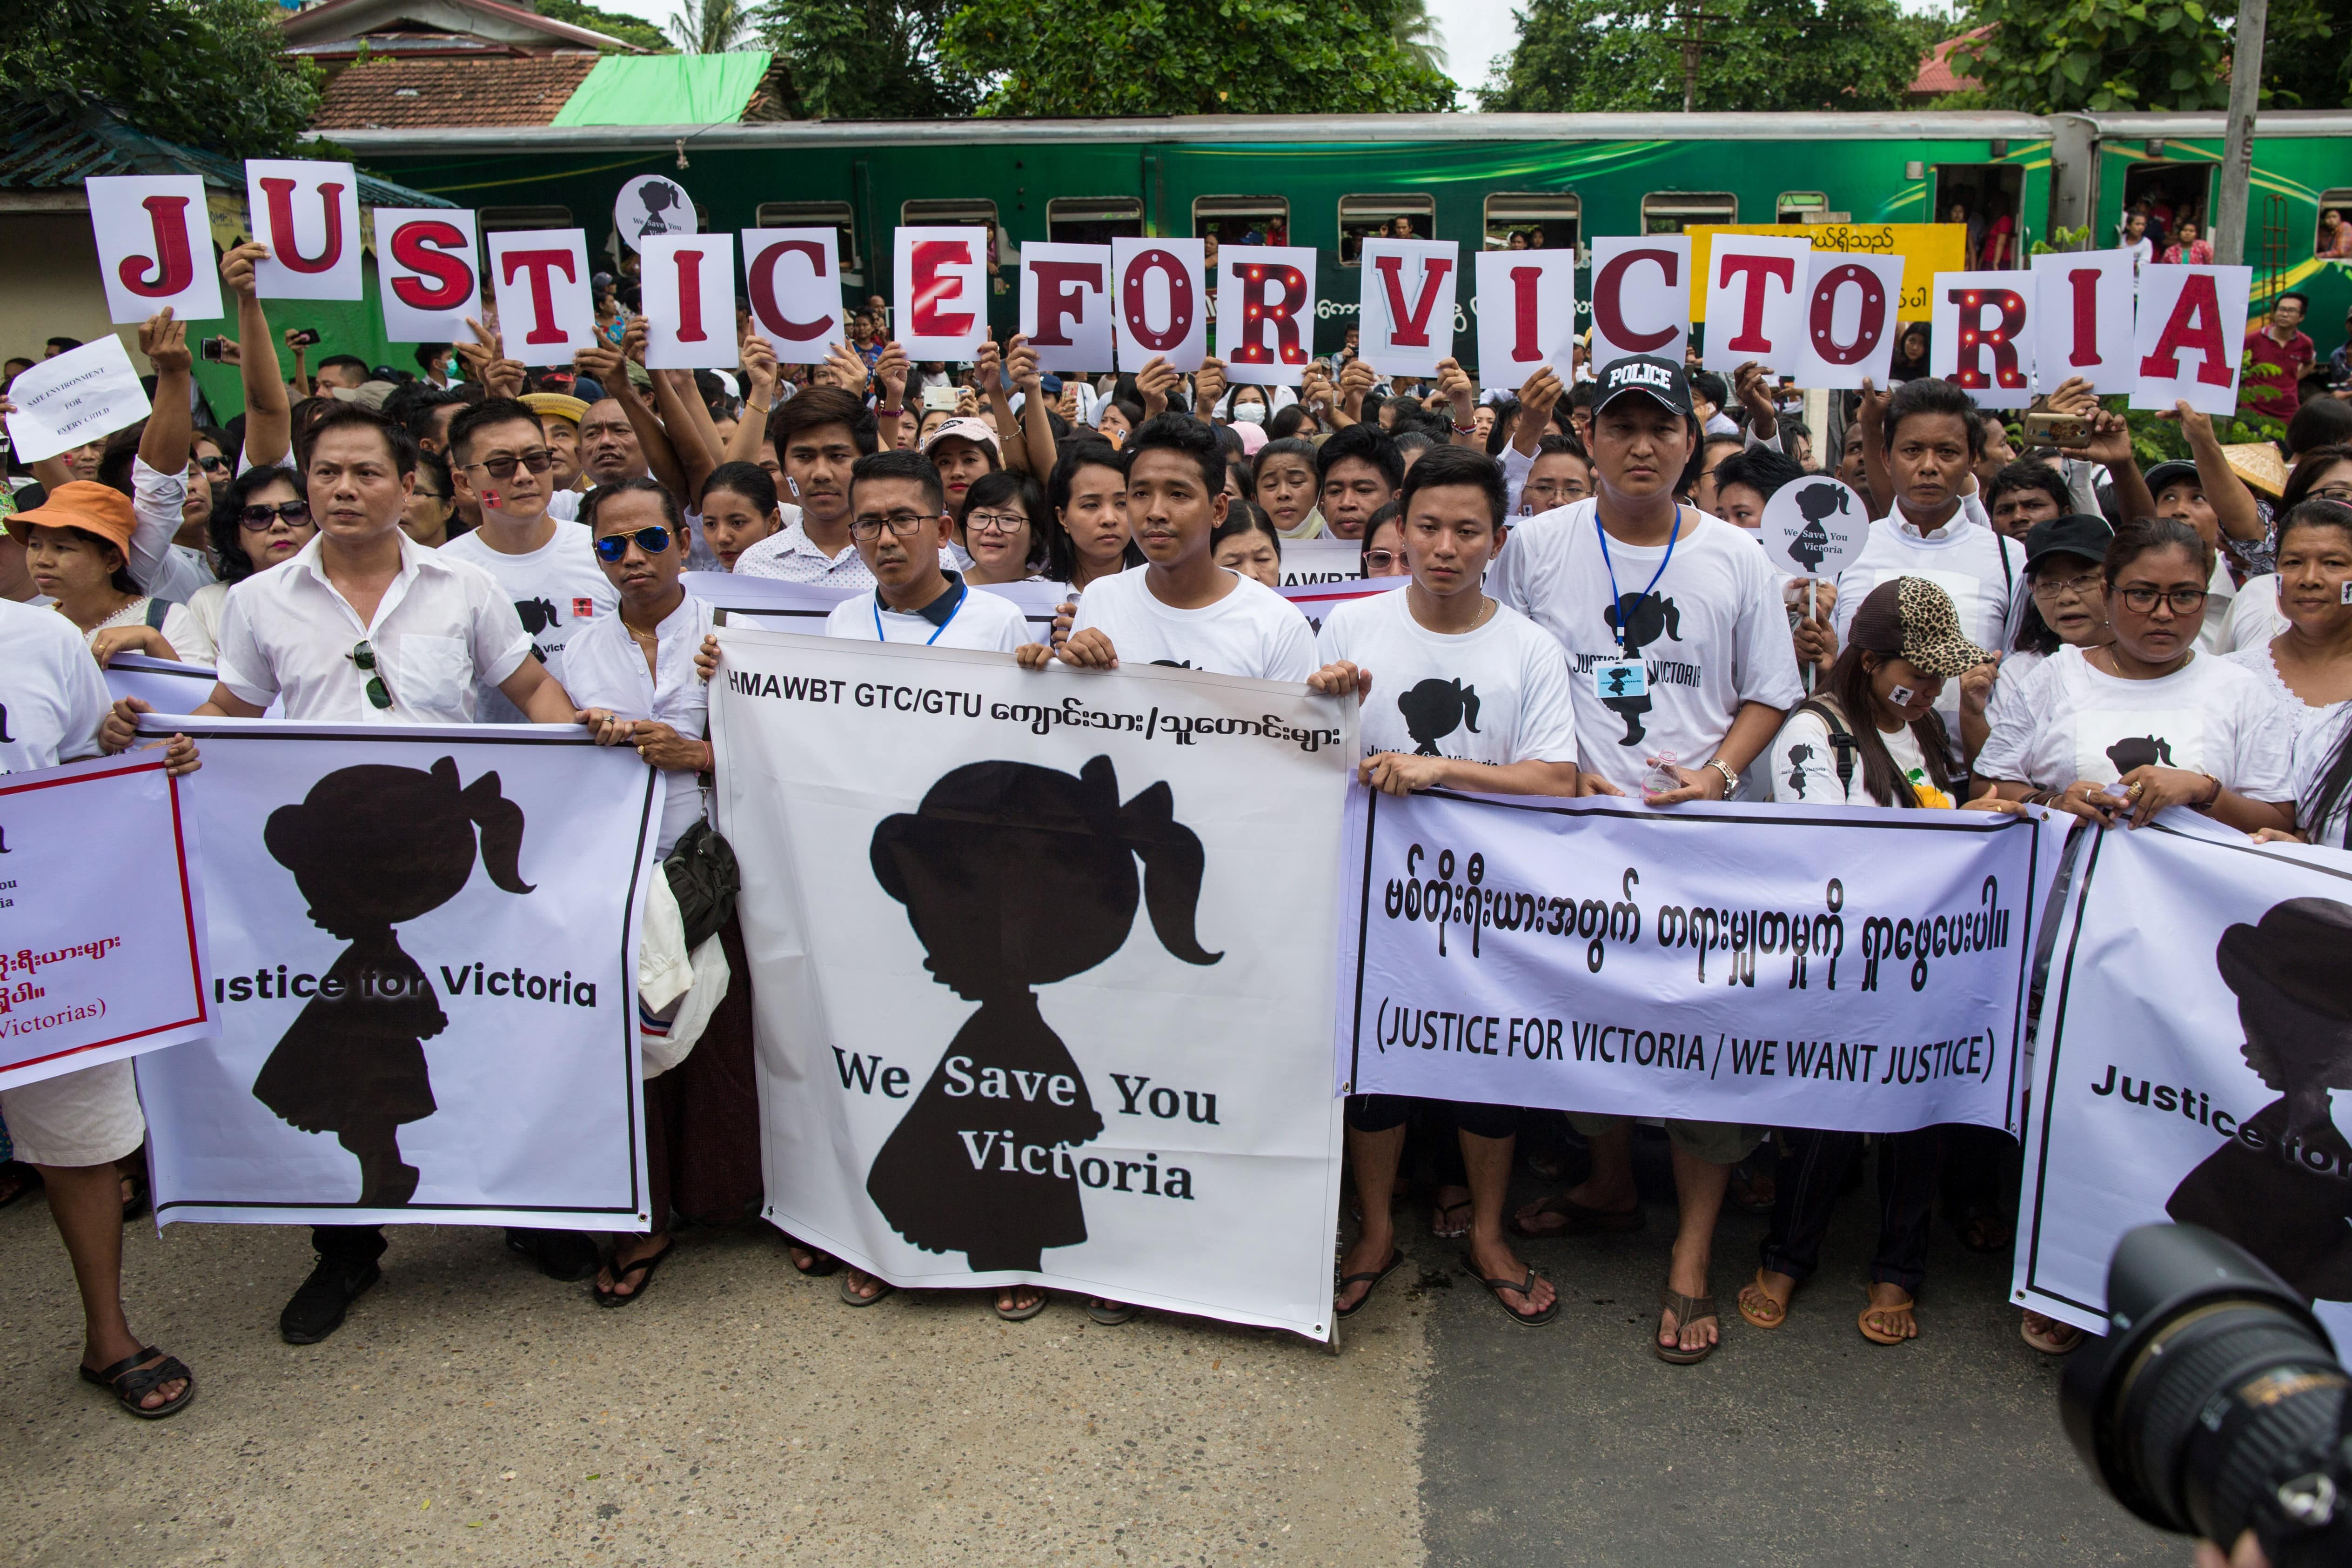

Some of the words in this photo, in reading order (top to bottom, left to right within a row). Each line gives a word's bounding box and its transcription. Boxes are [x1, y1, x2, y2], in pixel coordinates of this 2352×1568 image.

[27, 394, 46, 407] SAFE
[46, 367, 104, 397] ENVIRONMENT
[1608, 363, 1672, 391] POLICE
[57, 419, 83, 435] EVERY
[84, 407, 110, 422] CHILD
[65, 398, 82, 410] FOR
[1803, 530, 1824, 539] Save
[1830, 533, 1848, 541] You
[1804, 543, 1843, 554] Victoria
[727, 669, 846, 704] HMAWBT
[855, 683, 982, 718] GTC/GTU
[362, 970, 425, 997] for
[439, 962, 597, 1008] Victoria
[1377, 996, 1500, 1056] (JUSTICE
[1508, 1017, 1563, 1060] FOR
[1572, 1021, 1705, 1071] VICTORIA
[1731, 1038, 1778, 1076] WE
[1787, 1041, 1877, 1083] WANT
[1881, 1026, 1994, 1084] JUSTICE)
[831, 1045, 910, 1099] We
[944, 1055, 1076, 1107] Save
[1110, 1072, 1220, 1125] You
[2091, 1065, 2265, 1149] Justice
[958, 1130, 1195, 1200] Victoria
